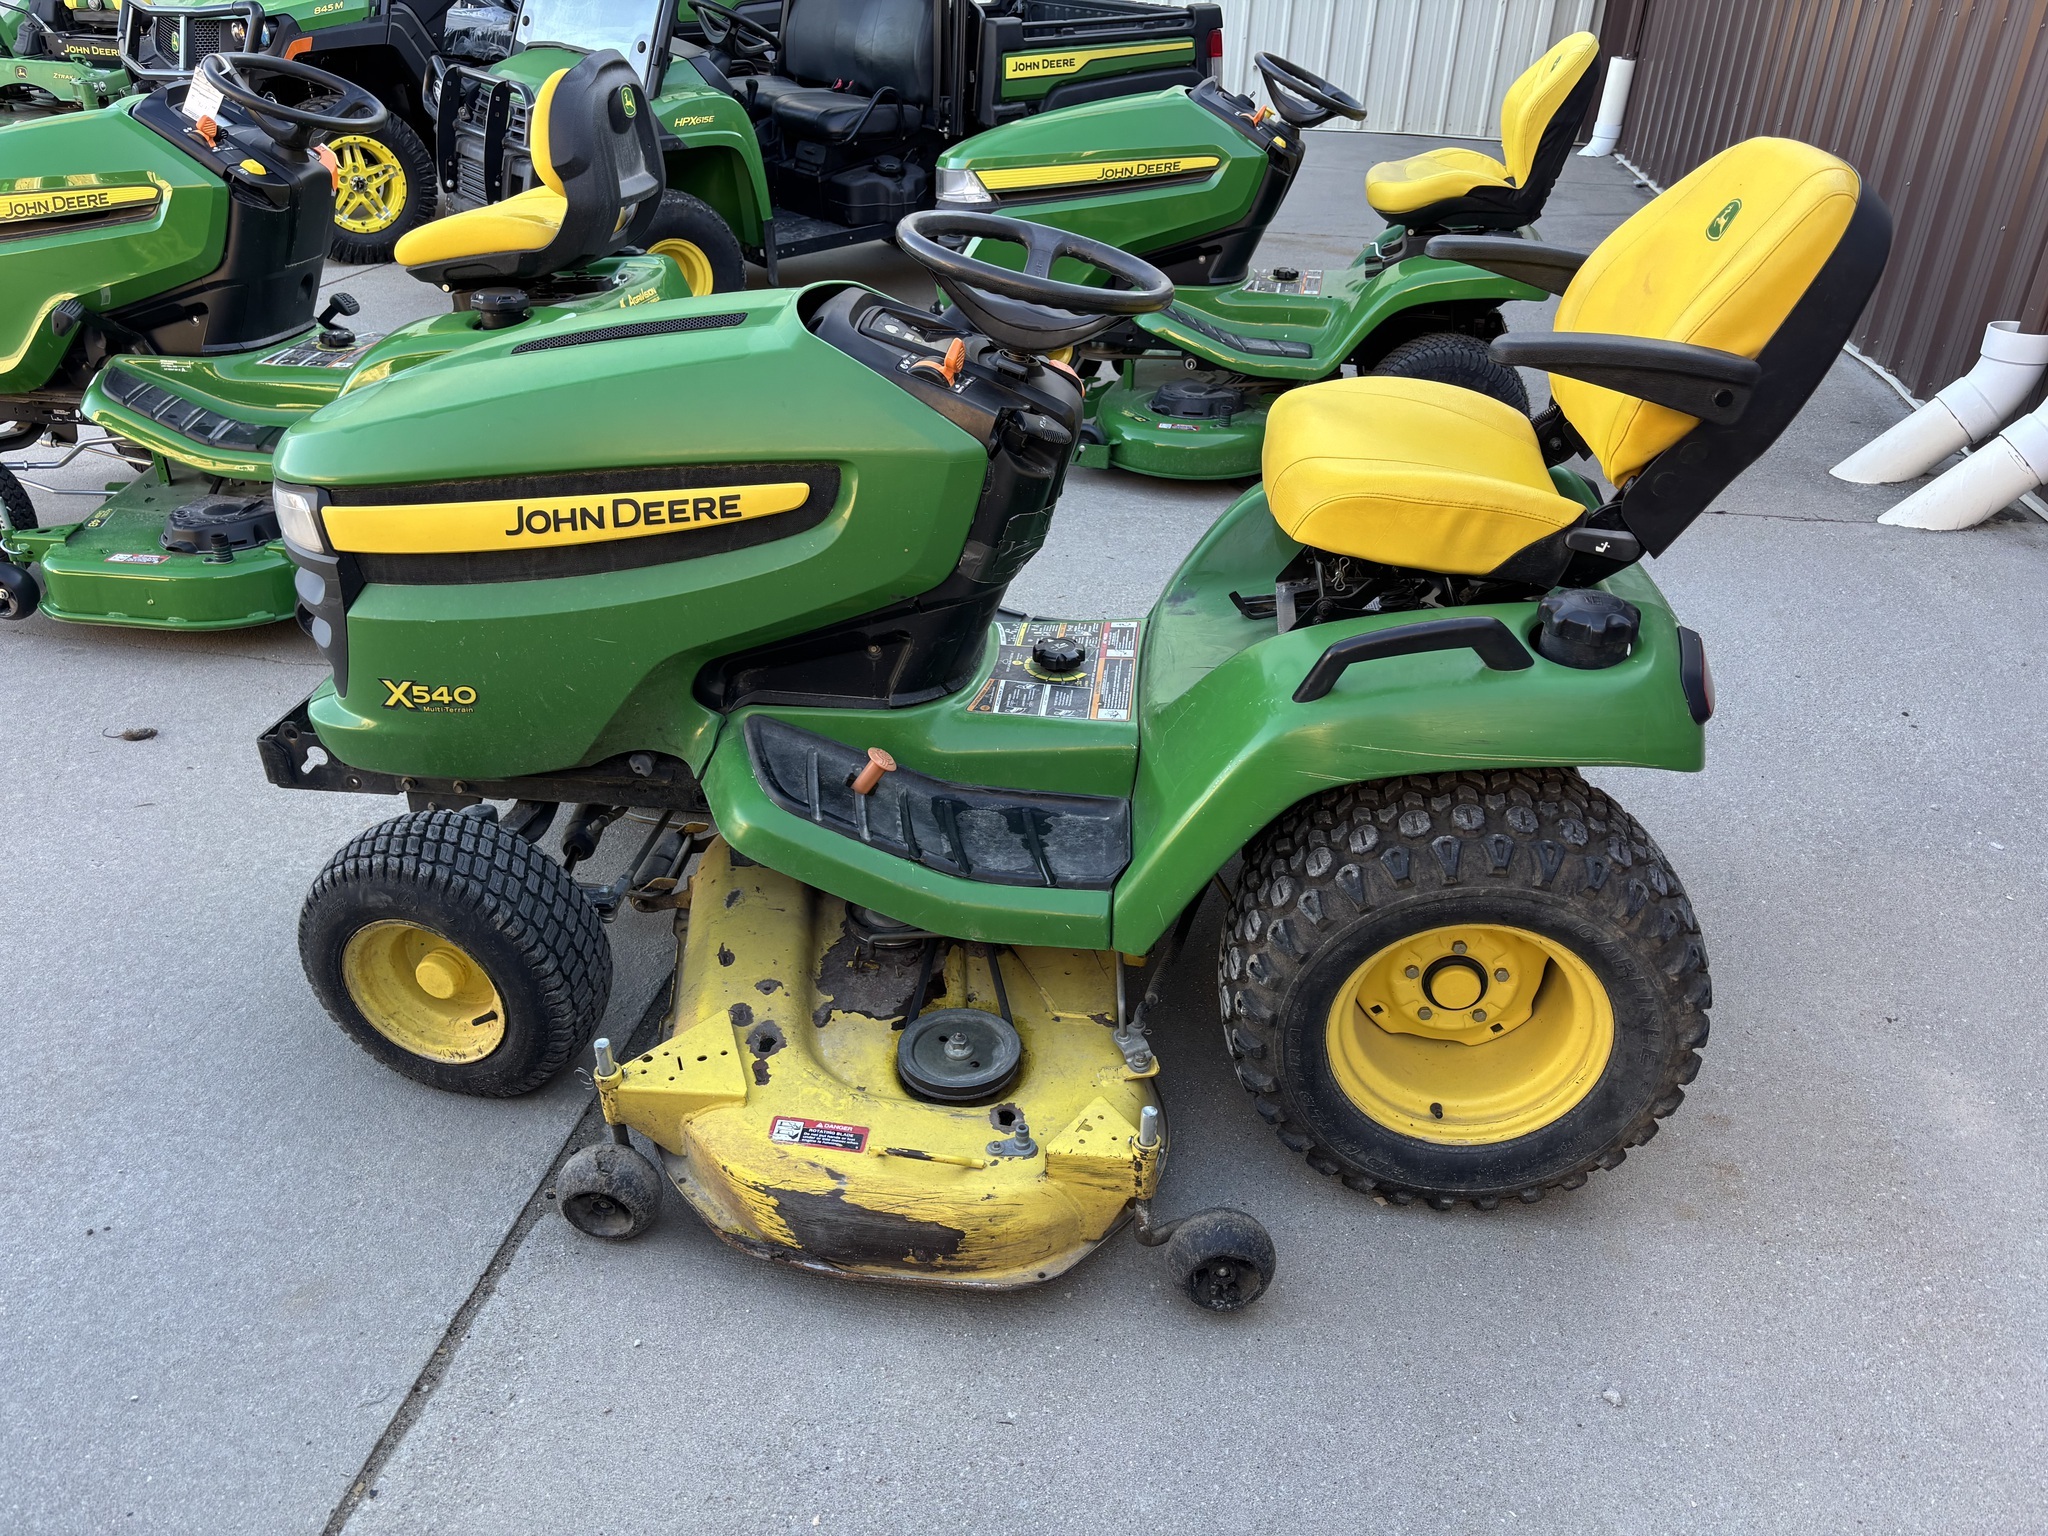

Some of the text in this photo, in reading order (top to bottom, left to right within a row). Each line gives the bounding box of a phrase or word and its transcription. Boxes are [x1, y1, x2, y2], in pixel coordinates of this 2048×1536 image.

[64, 43, 121, 57] JOHN DEER
[1012, 58, 1076, 72] JOHN DEERE
[674, 115, 715, 128] HPX615E
[1097, 161, 1182, 180] JOHN DEERE
[5, 192, 110, 217] JOHN DEERE
[505, 494, 742, 536] JOHN DEERE
[378, 678, 477, 709] X540
[1572, 922, 1661, 1066] CARLISLE
[824, 1123, 854, 1131] DANGER
